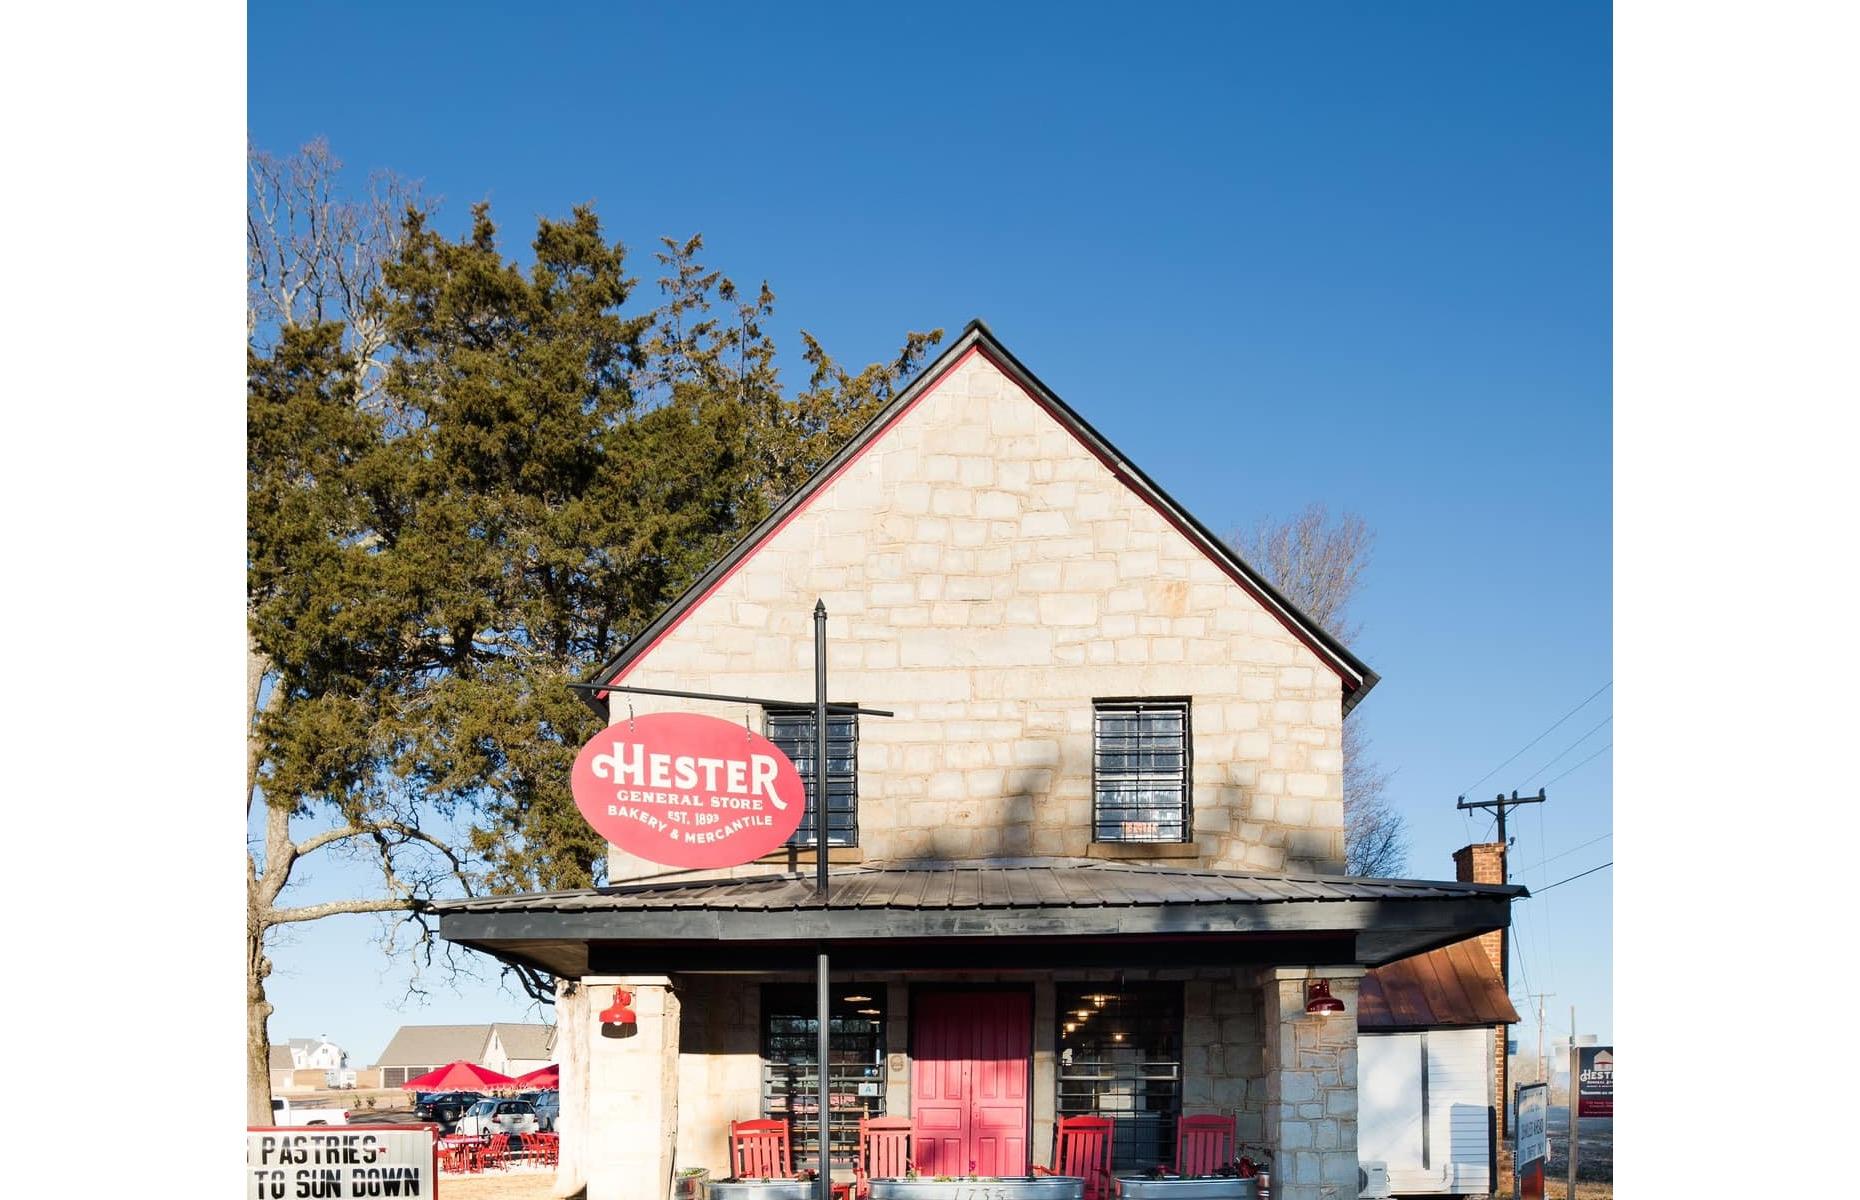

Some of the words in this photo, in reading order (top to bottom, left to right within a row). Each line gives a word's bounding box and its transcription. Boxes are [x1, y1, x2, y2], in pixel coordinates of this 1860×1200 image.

[591, 742, 788, 810] HESTER
[617, 790, 703, 807] GENERAL
[710, 797, 763, 811] STORE
[607, 805, 666, 833] BAKERY
[669, 829, 679, 841] &
[684, 815, 773, 844] MERCANTILE
[667, 810, 690, 825] EST.
[262, 1135, 377, 1165] PASTRIES
[254, 1170, 285, 1200] TO
[296, 1169, 341, 1198] SUN
[352, 1167, 420, 1197] DOWN
